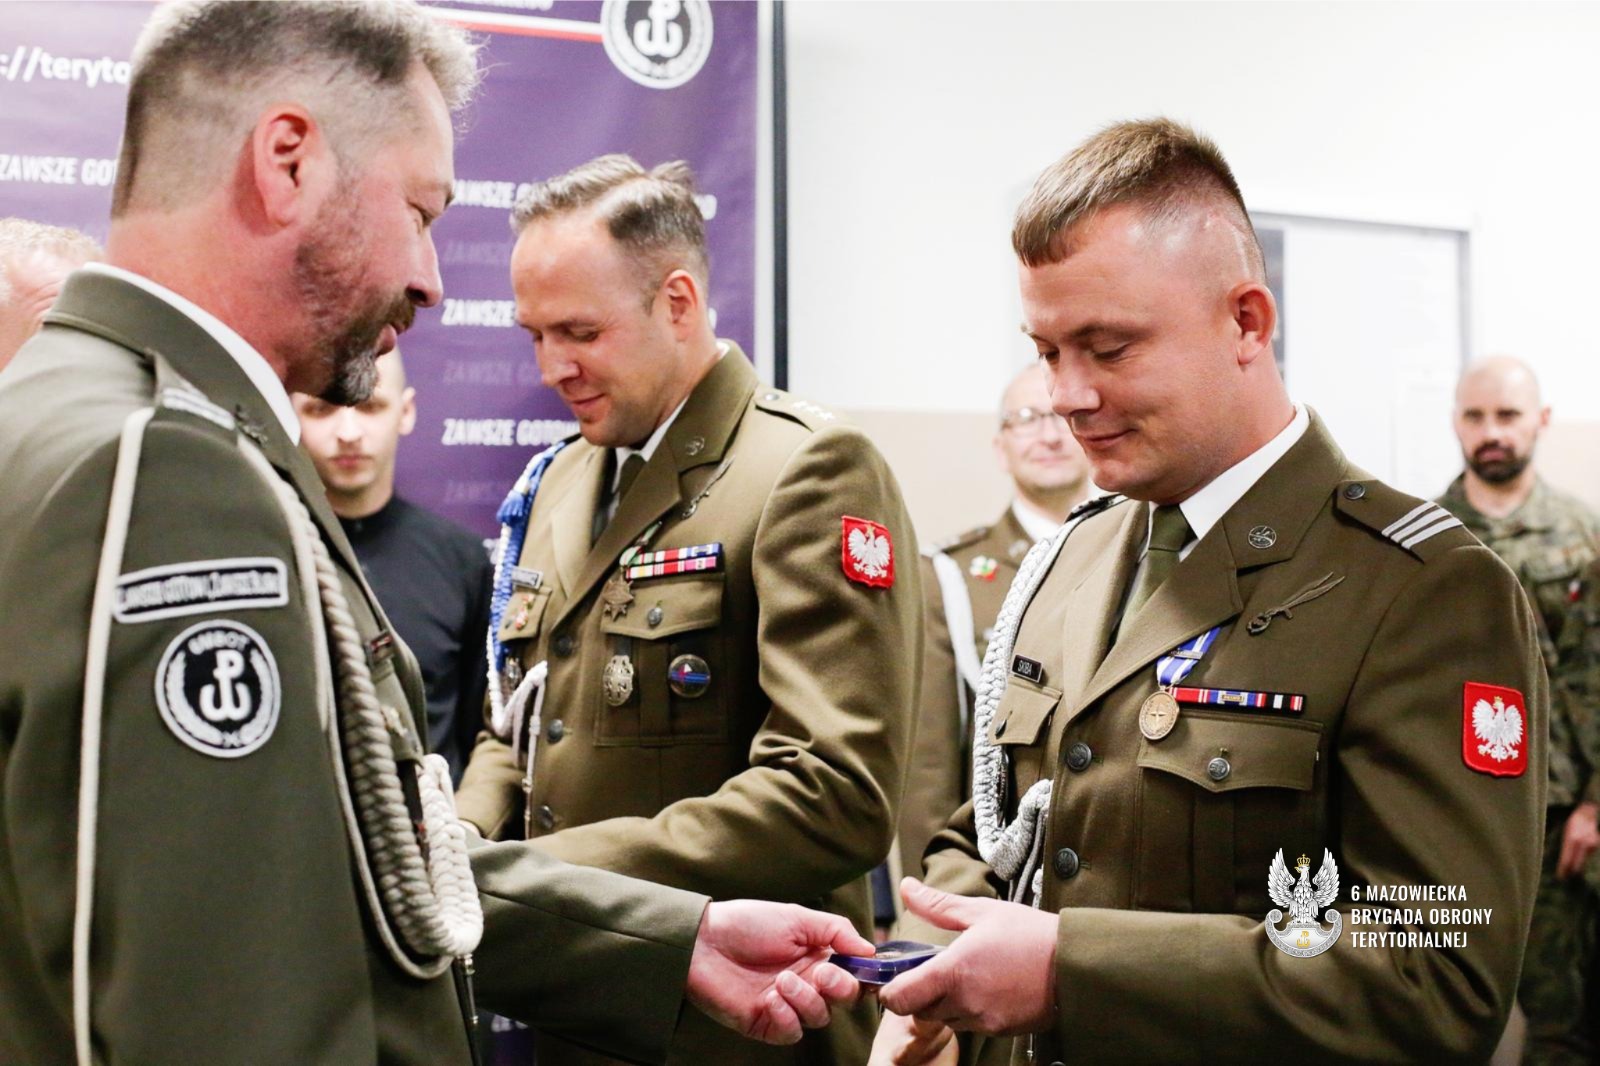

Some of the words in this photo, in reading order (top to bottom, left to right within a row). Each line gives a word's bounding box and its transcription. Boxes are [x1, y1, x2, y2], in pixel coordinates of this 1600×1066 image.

[0, 154, 78, 184] ZAWSZE
[441, 299, 515, 327] ZAWSZE
[441, 418, 515, 446] ZAWSZE
